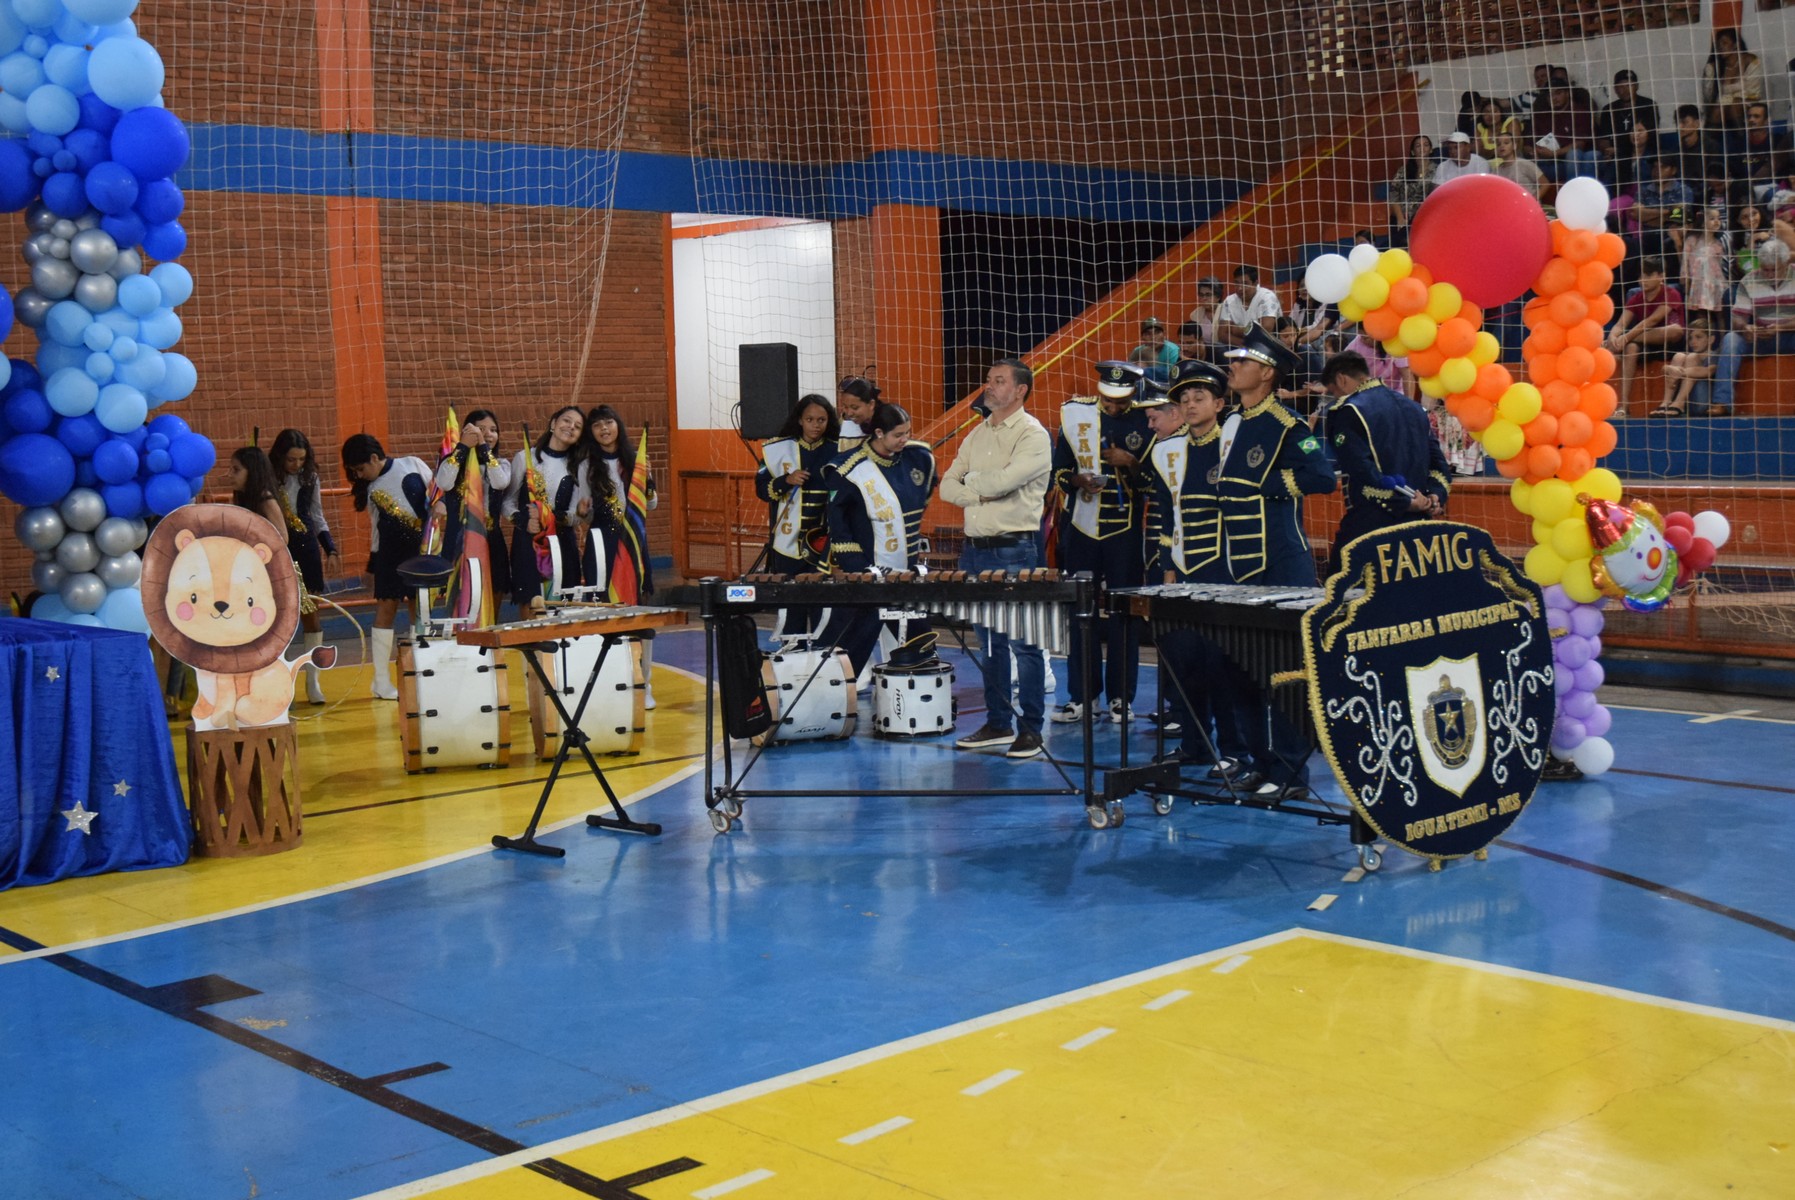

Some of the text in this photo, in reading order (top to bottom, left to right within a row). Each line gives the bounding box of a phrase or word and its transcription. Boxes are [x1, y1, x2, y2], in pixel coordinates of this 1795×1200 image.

[1077, 422, 1094, 503] FAMG
[1376, 531, 1474, 584] FAMIG
[1346, 602, 1519, 653] FANFARRA MUNICIPAL
[1405, 803, 1489, 842] IGUATEMI
[1497, 793, 1521, 815] MS
